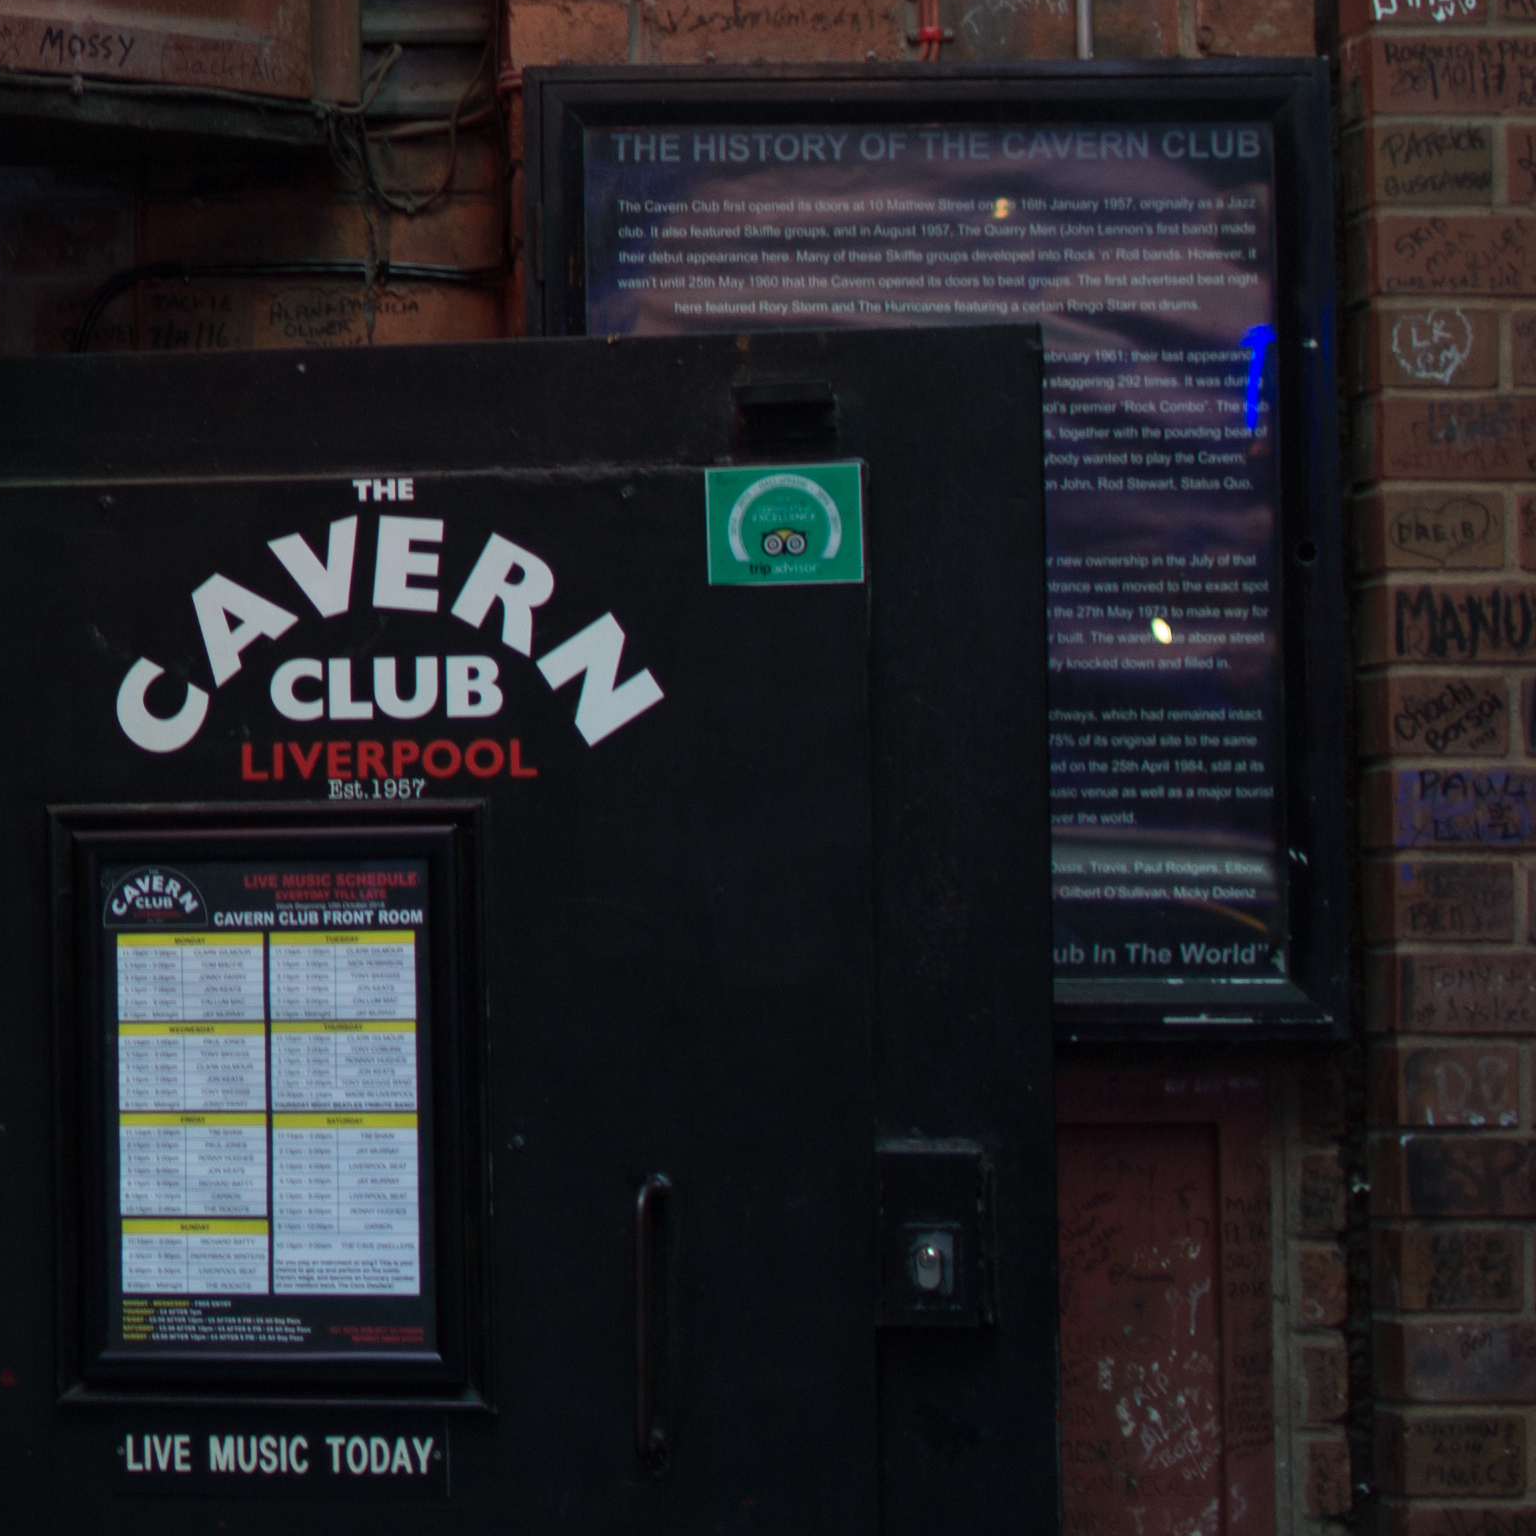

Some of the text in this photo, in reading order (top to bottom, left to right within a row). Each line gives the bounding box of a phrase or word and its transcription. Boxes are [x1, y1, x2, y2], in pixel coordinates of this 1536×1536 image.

[40, 26, 135, 64] MOSSY
[611, 130, 1260, 162] THE HISTORY OF THE CAVERN CLUB
[618, 198, 849, 216] The Cavern Club first opened its doors
[353, 478, 414, 501] THE
[116, 515, 665, 752] CAVERN
[270, 655, 503, 720] CLUB
[241, 739, 538, 782] LIVERPOOL
[328, 778, 425, 800] Est.1957
[244, 872, 417, 889] LIVE MUSIC SCHEDULE
[112, 875, 198, 916] CAVERN
[135, 896, 173, 909] CLUB
[214, 909, 423, 927] CAVERN CLUB FRONT ROOM
[1093, 943, 1116, 963] In
[1125, 943, 1171, 963] The
[126, 1434, 433, 1474] LIVE MUSIC TODAY
